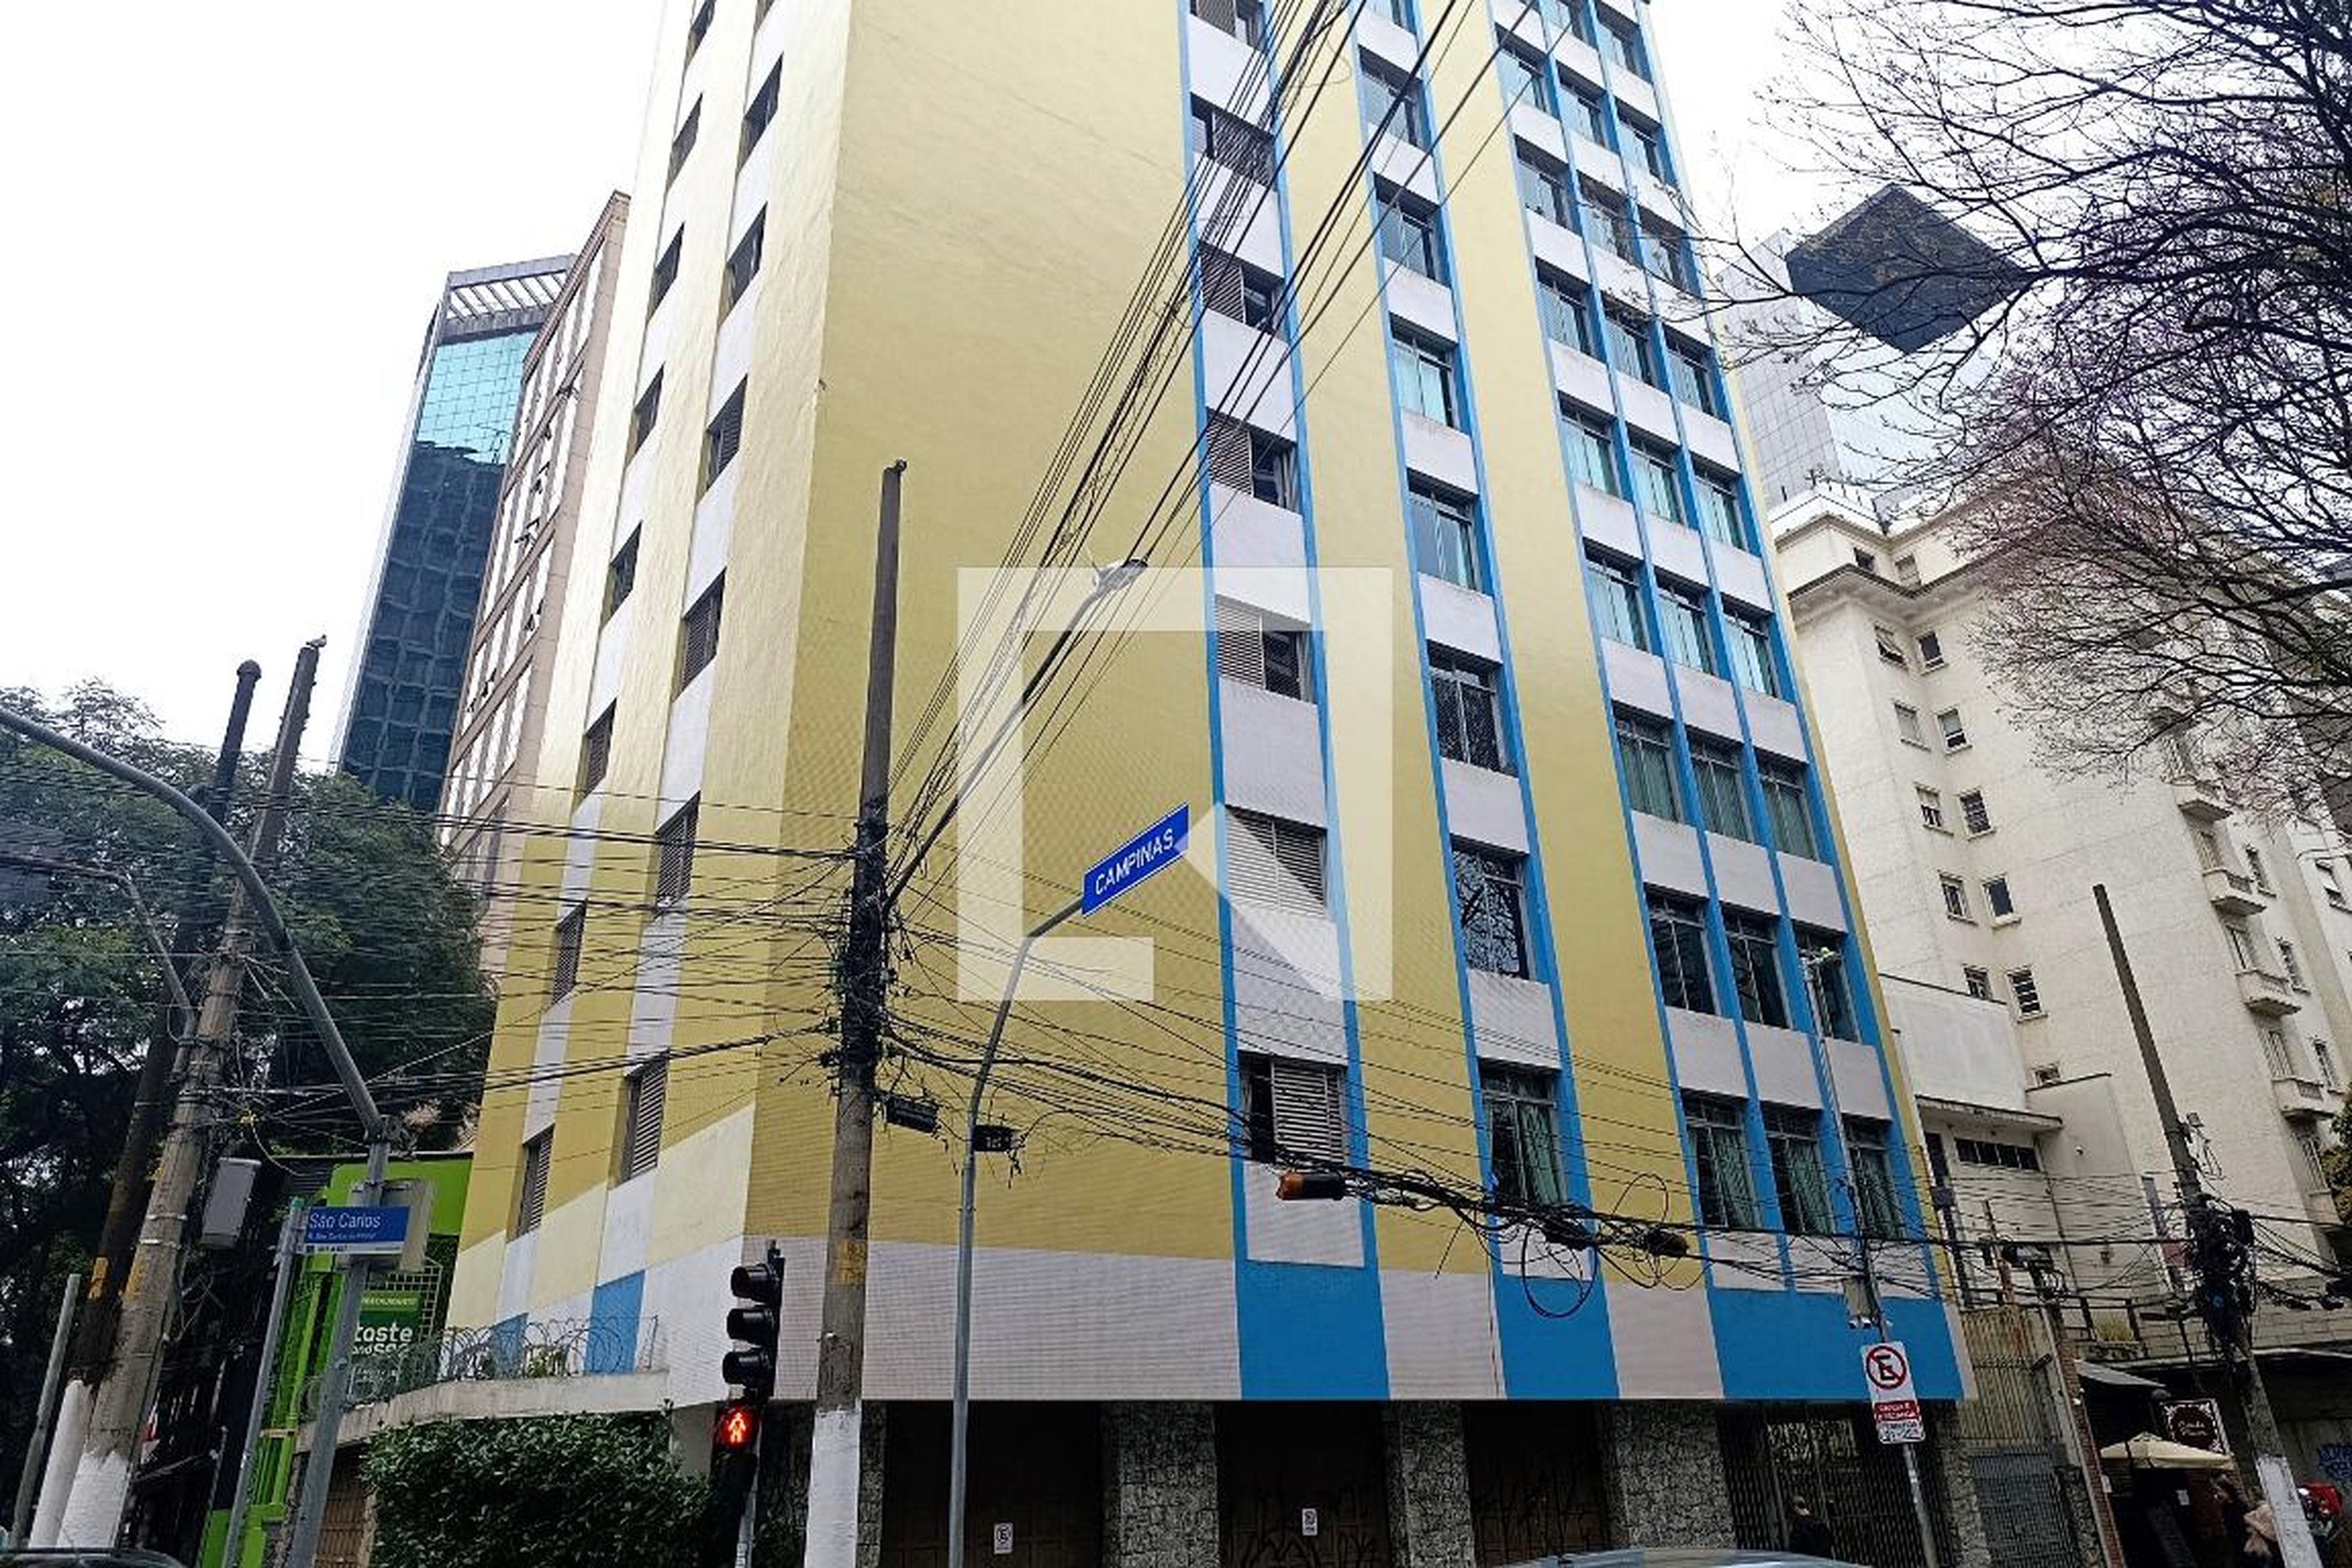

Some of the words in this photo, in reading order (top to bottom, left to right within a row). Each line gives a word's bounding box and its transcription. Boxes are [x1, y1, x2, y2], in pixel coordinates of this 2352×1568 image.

[1095, 827, 1174, 895] CAMPINAS
[339, 1212, 381, 1229] Carlos
[355, 1320, 413, 1342] taste
